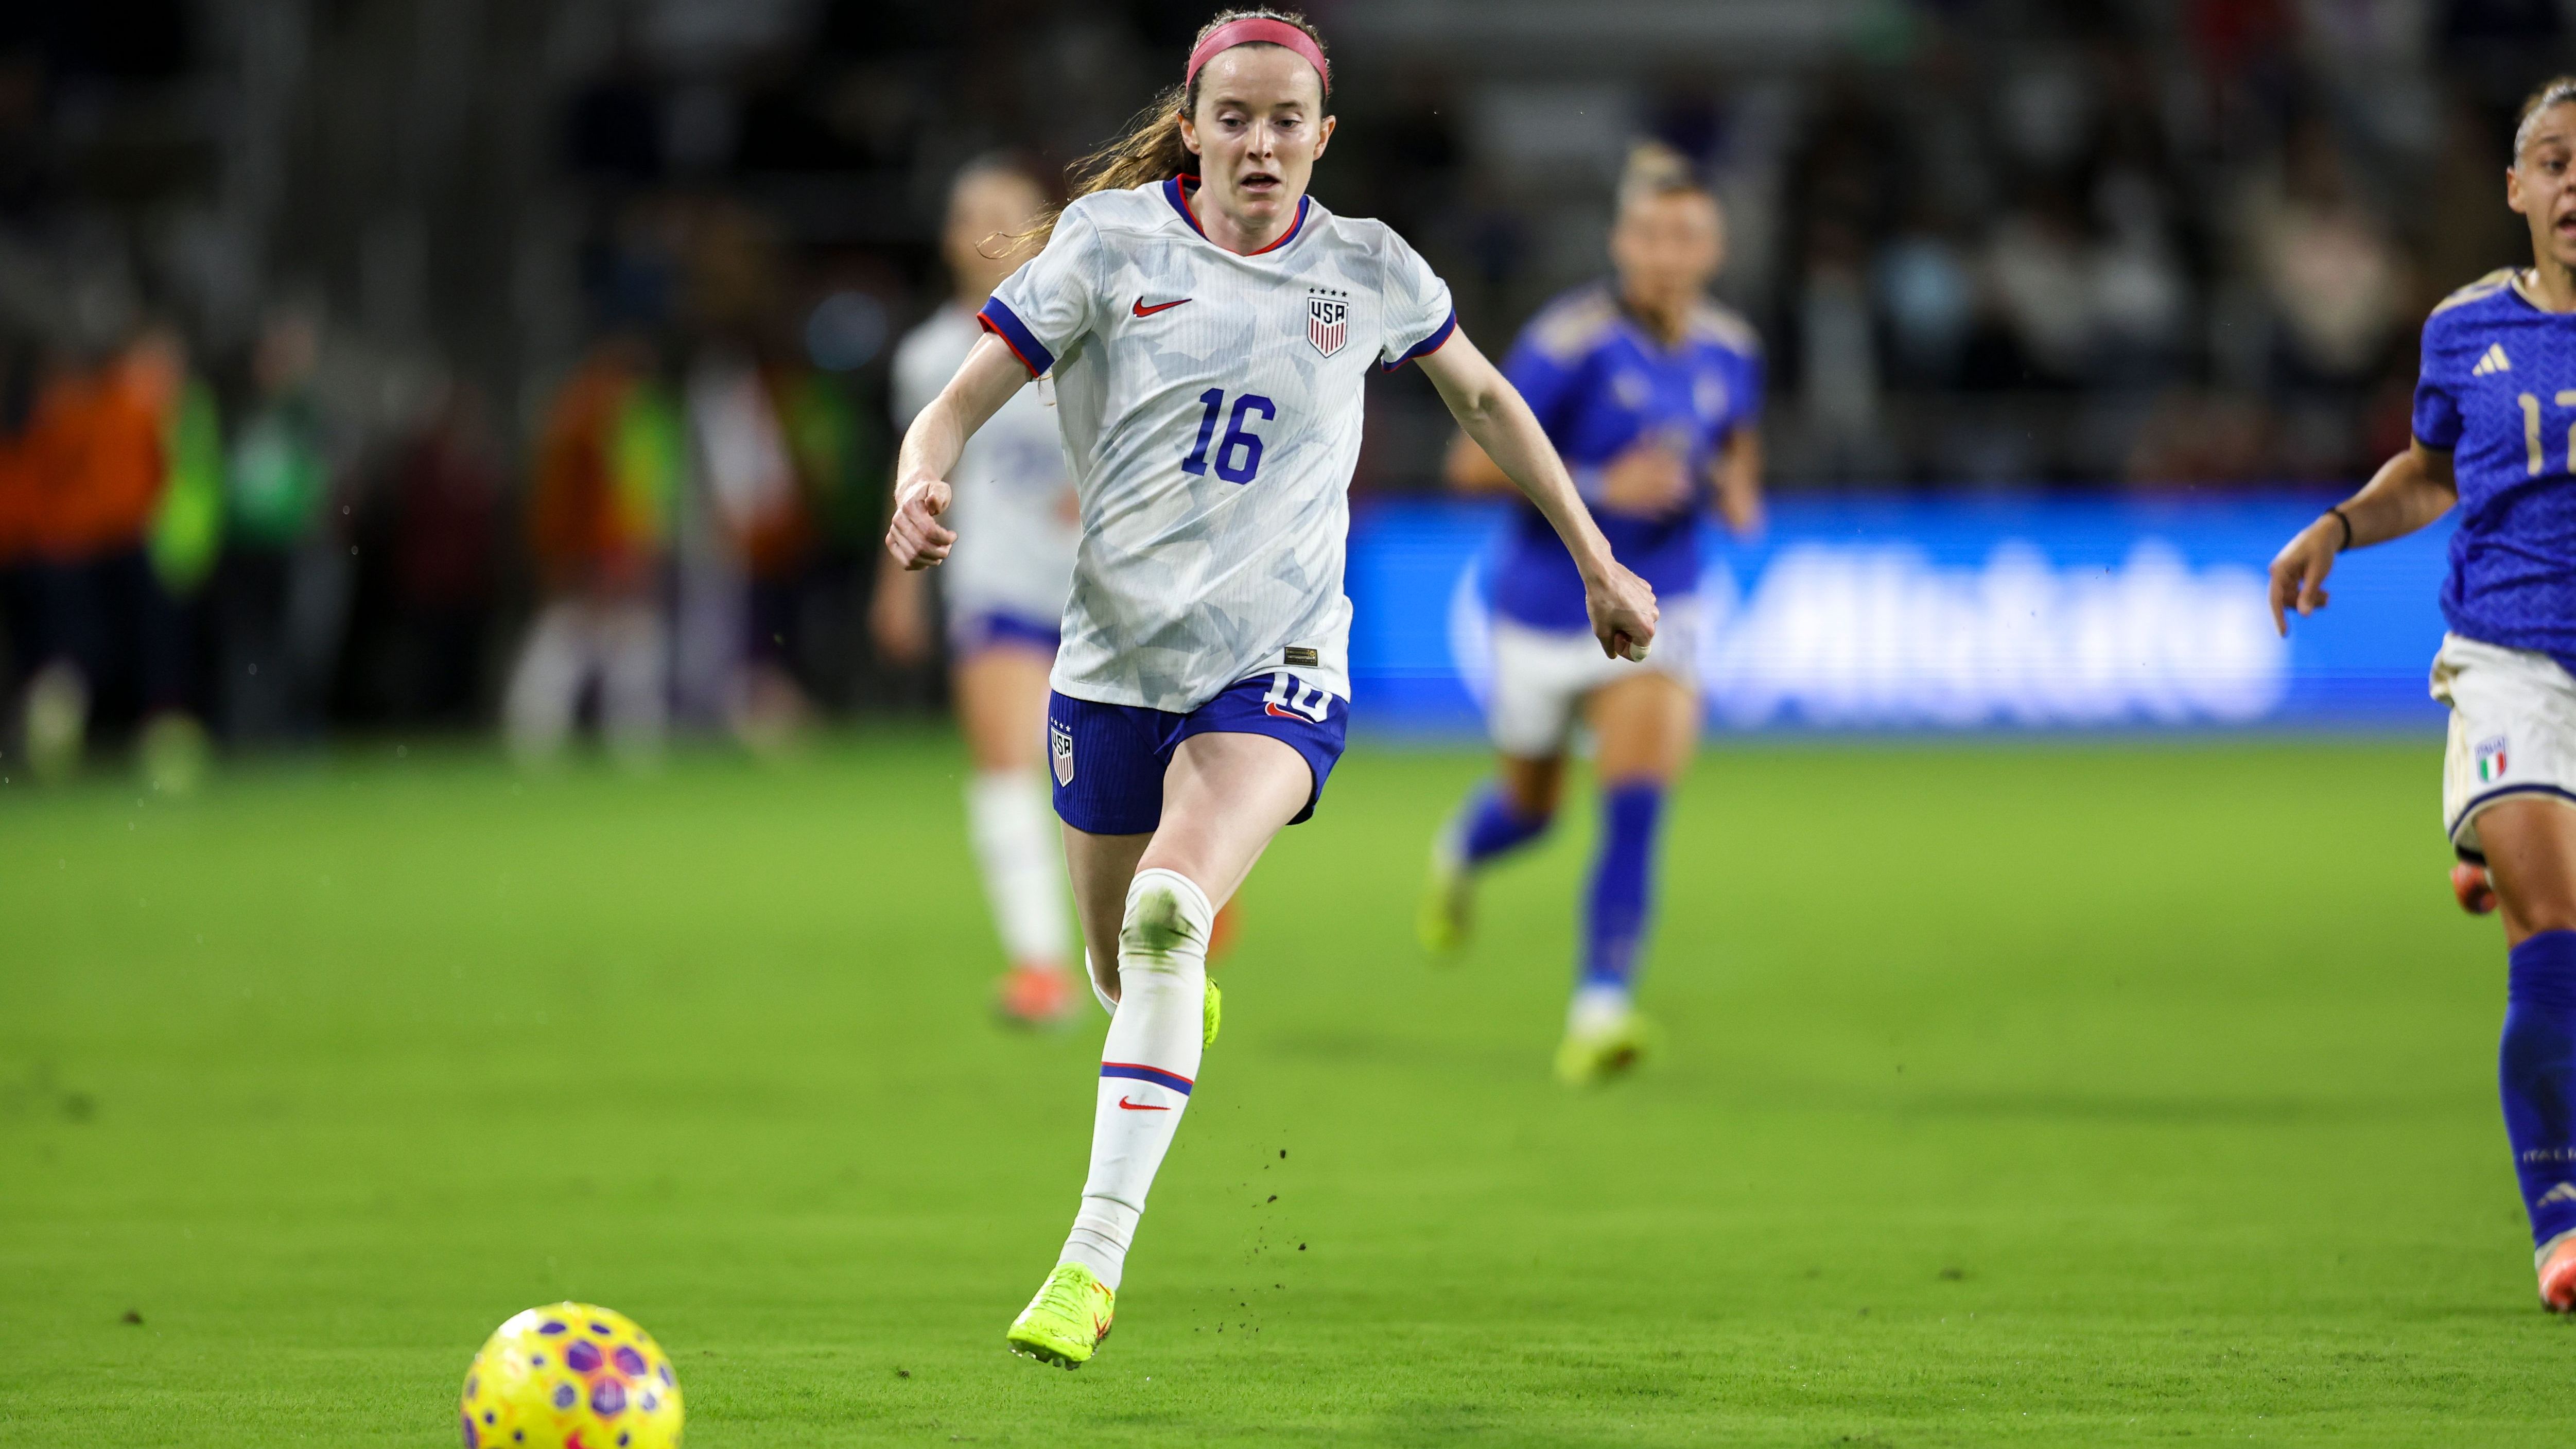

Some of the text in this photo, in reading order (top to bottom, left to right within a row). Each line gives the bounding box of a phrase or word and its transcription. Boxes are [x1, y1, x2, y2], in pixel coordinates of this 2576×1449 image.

[1311, 301, 1345, 324] USA
[1181, 388, 1276, 485] 16
[1052, 730, 1070, 756] USA
[2523, 1147, 2576, 1162] ITALI
